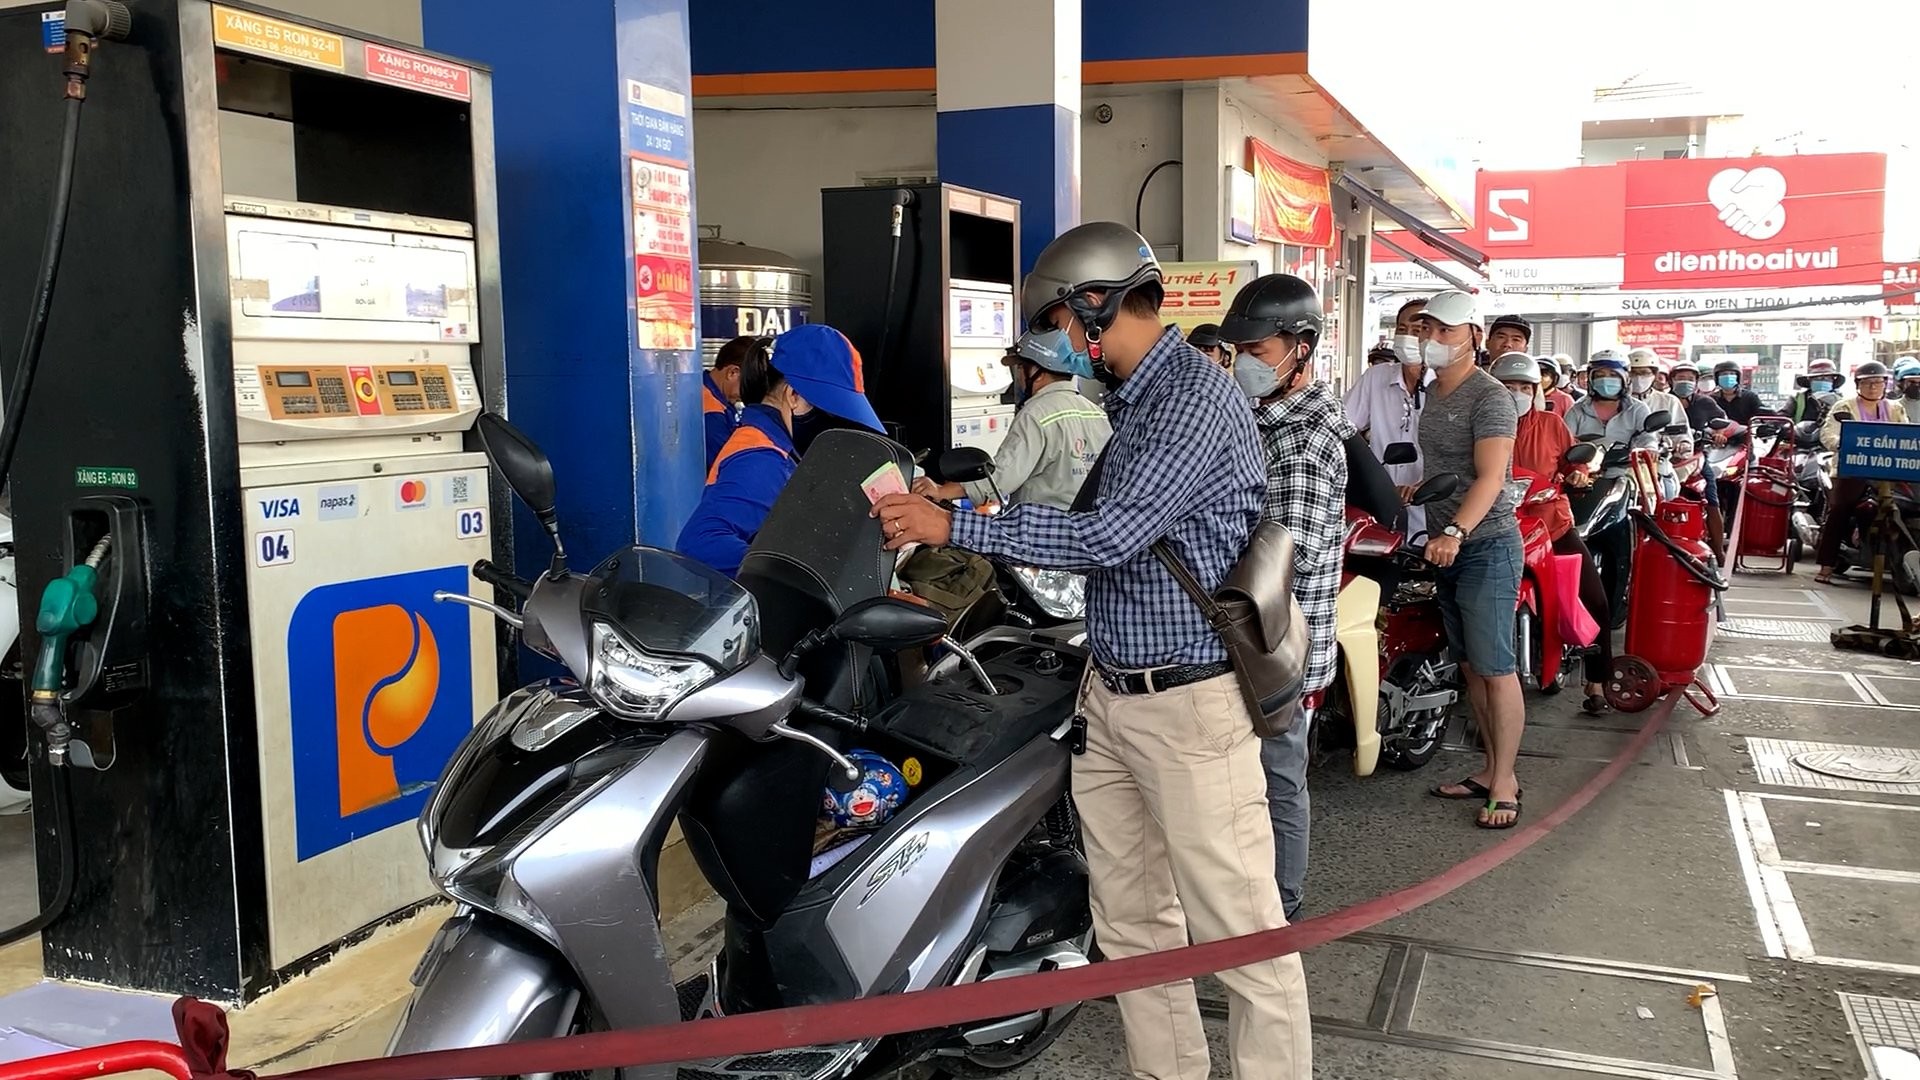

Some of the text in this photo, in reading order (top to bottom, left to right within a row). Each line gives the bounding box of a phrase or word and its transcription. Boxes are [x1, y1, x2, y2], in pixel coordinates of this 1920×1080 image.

[265, 25, 281, 40] E5
[283, 29, 310, 47] RON
[1654, 246, 1839, 273] dienthoaivui
[1856, 436, 1871, 448] XE
[77, 469, 97, 484] XĂNG
[98, 471, 107, 484] E5
[111, 472, 127, 485] RON
[127, 472, 136, 485] 92
[259, 497, 300, 519] VISA
[461, 511, 483, 535] 03
[262, 534, 290, 562] 04
